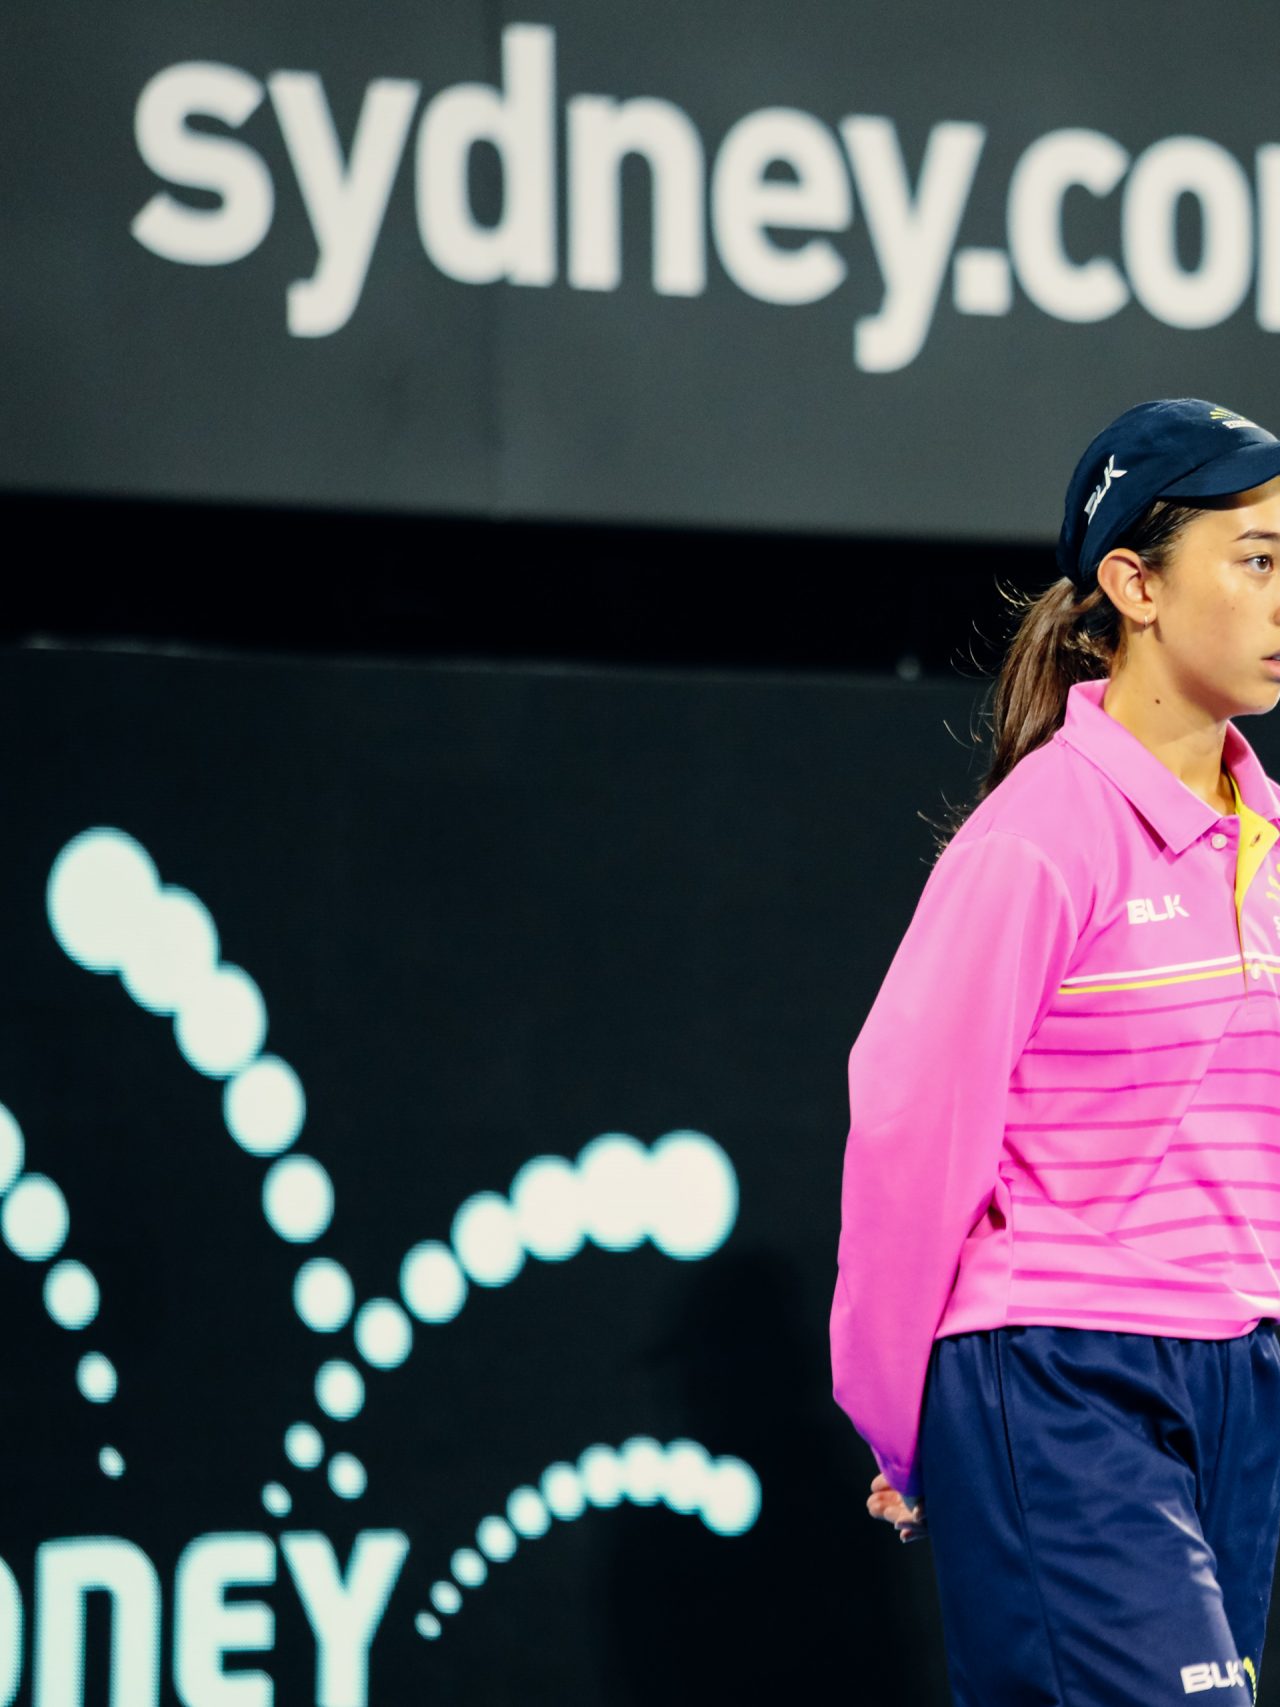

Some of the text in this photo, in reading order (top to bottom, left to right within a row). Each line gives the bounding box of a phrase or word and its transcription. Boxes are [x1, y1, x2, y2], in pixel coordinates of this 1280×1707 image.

[1127, 895, 1189, 925] BLK
[0, 1528, 409, 1707] NEY
[1180, 1660, 1244, 1694] BLK
